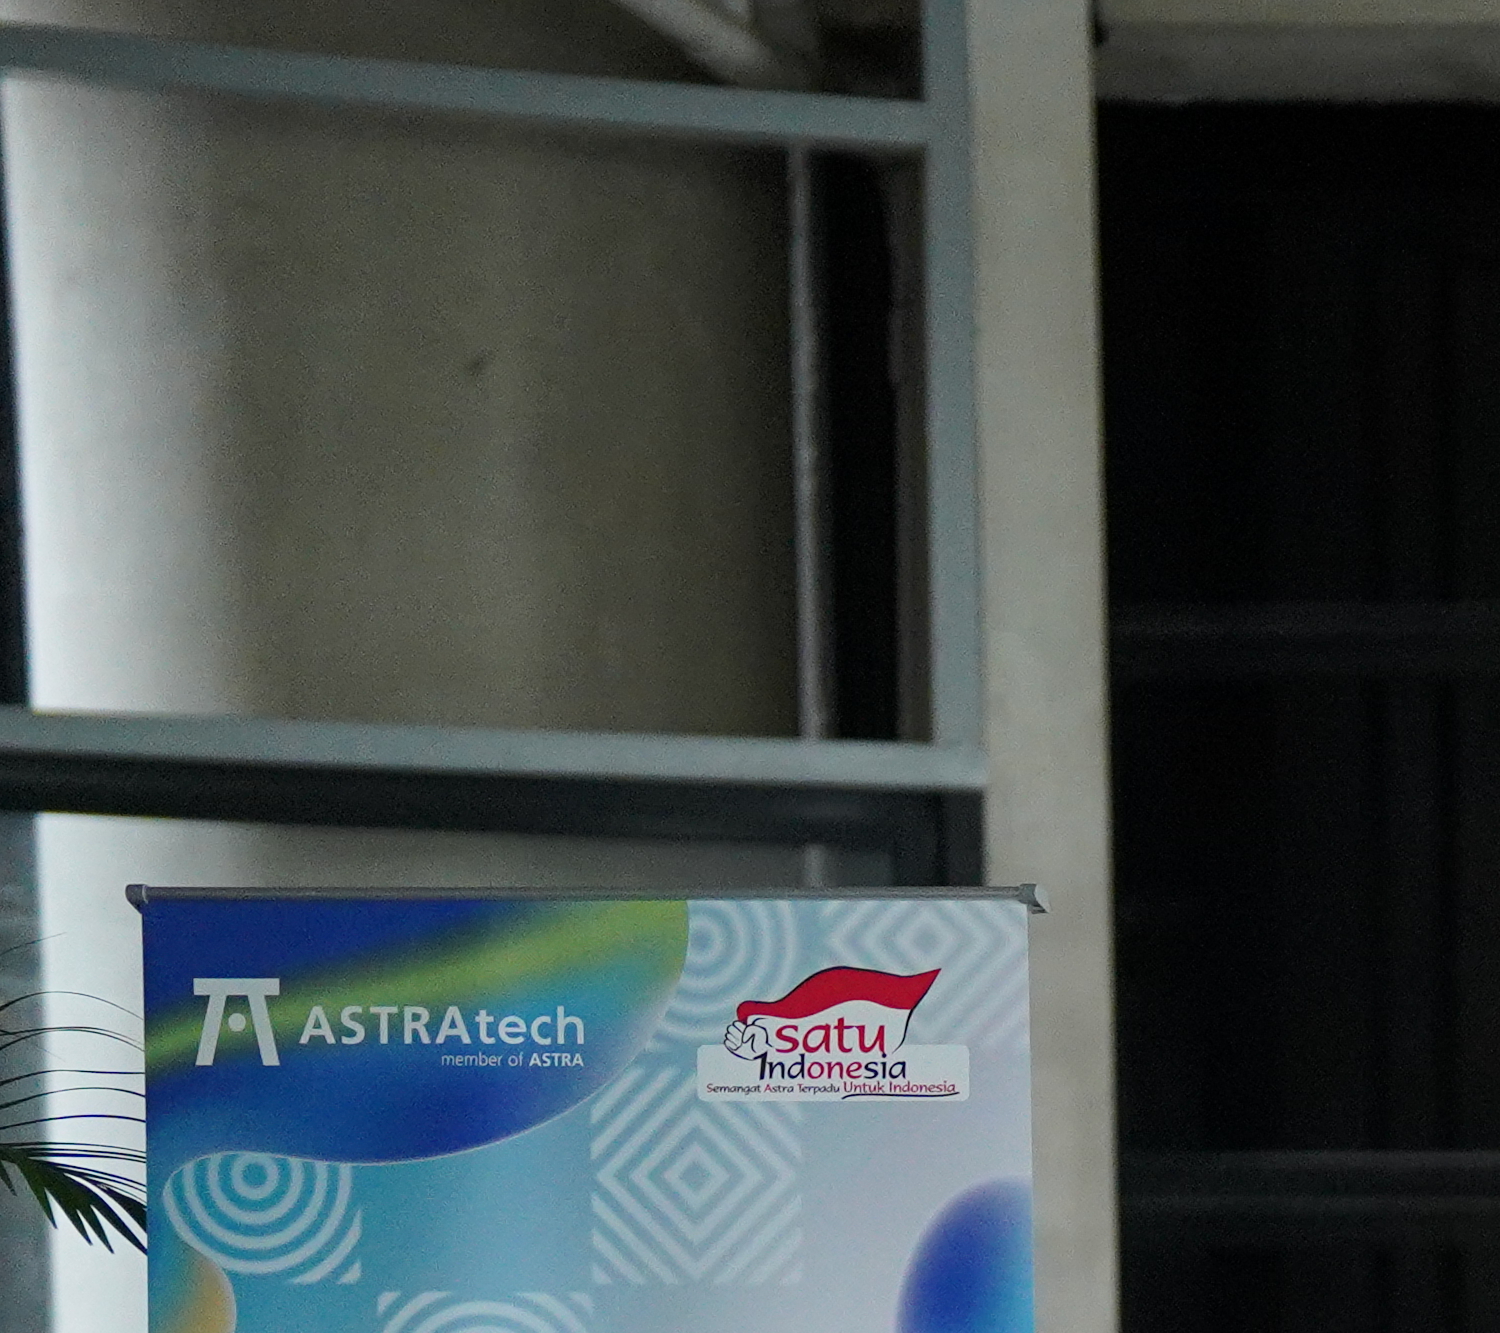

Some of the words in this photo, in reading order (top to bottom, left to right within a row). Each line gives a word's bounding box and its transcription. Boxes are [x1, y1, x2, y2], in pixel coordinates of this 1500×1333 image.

[299, 1005, 585, 1046] ASTRAtech
[775, 1017, 886, 1054] satu
[441, 1052, 504, 1066] member
[509, 1051, 525, 1066] of
[529, 1053, 585, 1067] ASTRA
[707, 1083, 761, 1094] Semangat
[764, 1083, 794, 1093] Astra
[798, 1083, 840, 1094] Terpadu
[843, 1081, 885, 1093] Untuk
[889, 1081, 956, 1093] Indonesia
